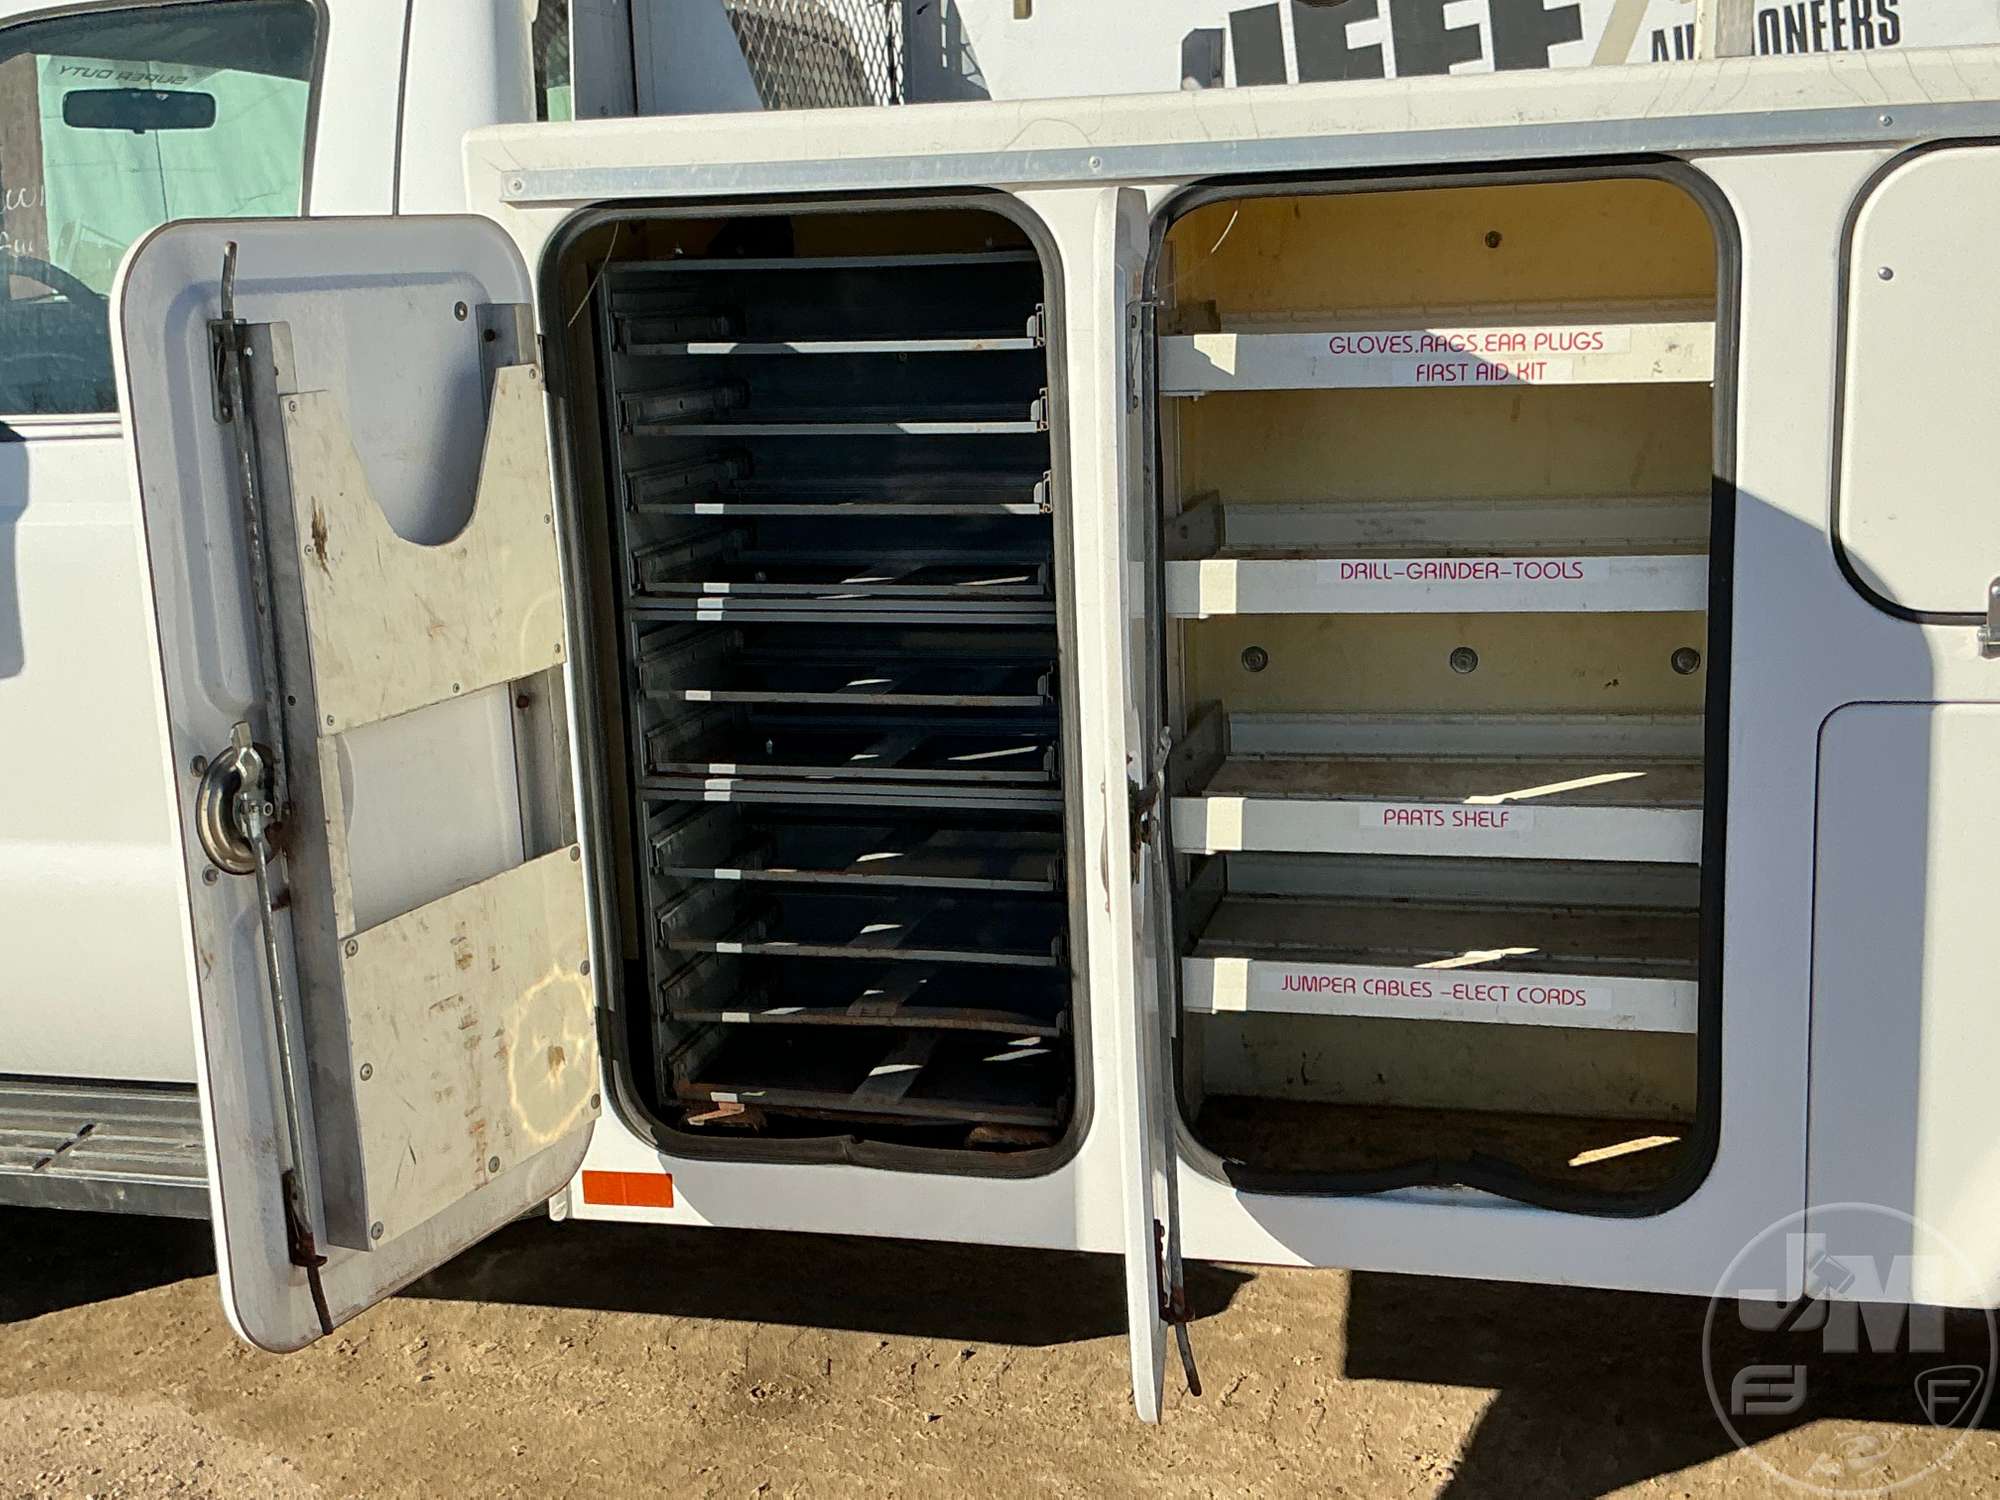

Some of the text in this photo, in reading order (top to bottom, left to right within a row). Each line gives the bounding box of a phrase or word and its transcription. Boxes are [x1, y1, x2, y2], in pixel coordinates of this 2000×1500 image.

[1533, 331, 1604, 352] PLUGS
[1415, 361, 1548, 383] FIRST AID KIT
[1340, 561, 1584, 581] DRILL-GRINDER-TOOLS
[1383, 808, 1510, 828] PARTS SHELF
[1281, 974, 1357, 995] JUMPER
[1363, 978, 1433, 999] CABLES
[1516, 986, 1587, 1007] CORDS
